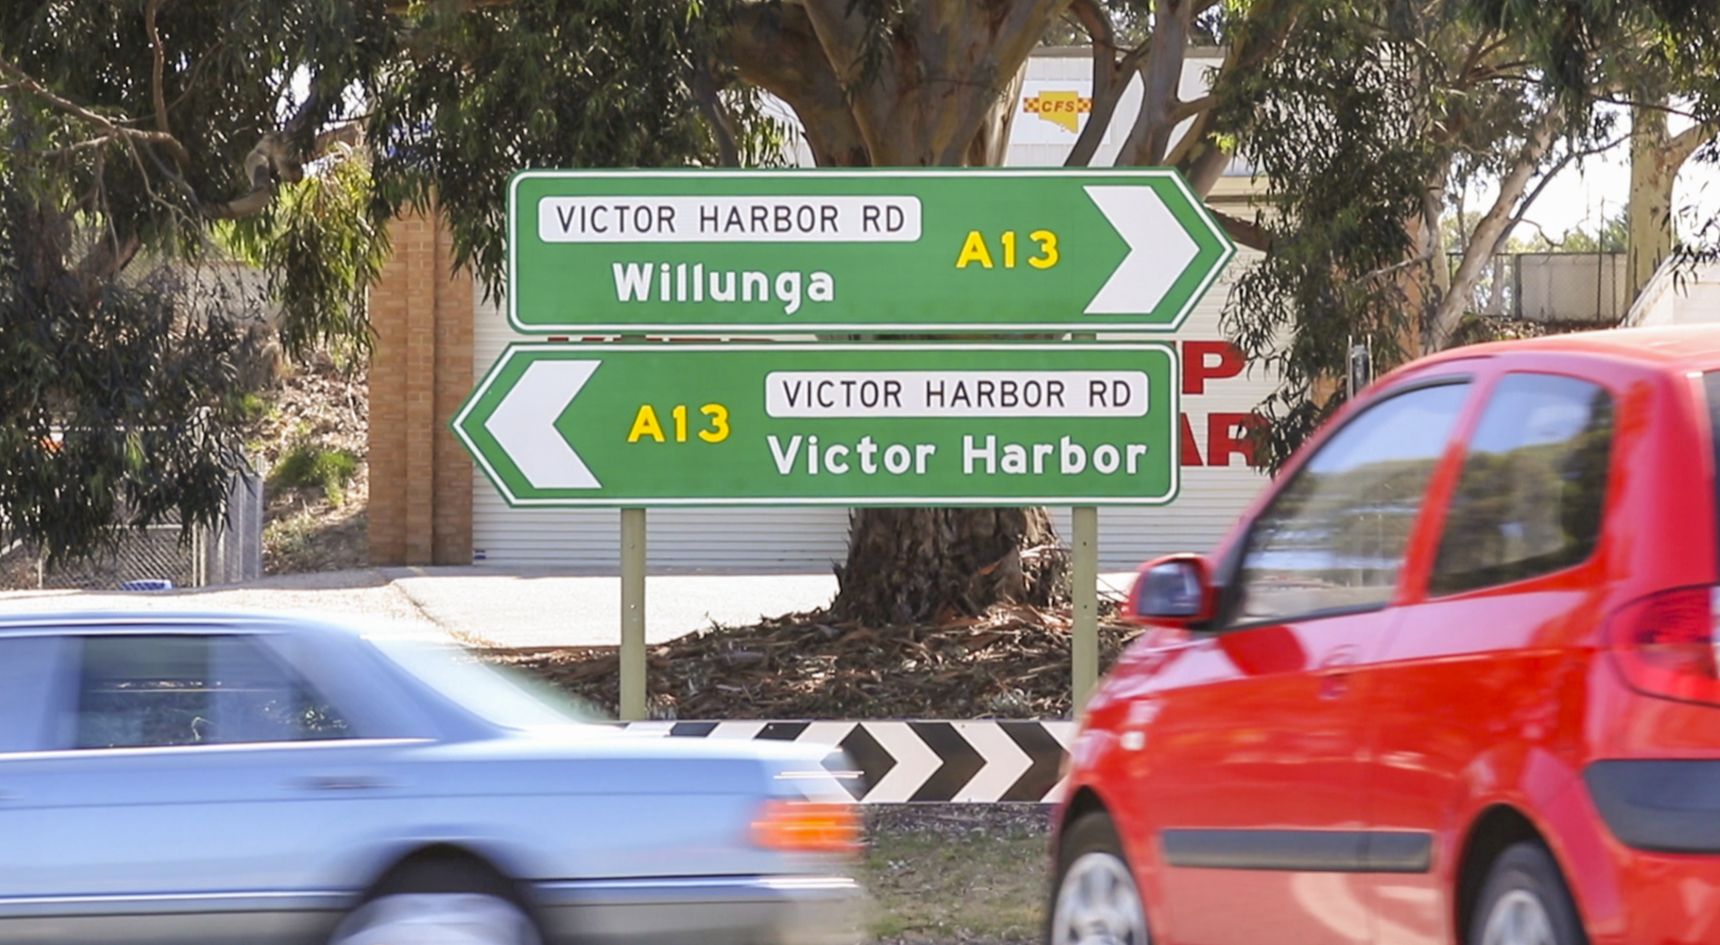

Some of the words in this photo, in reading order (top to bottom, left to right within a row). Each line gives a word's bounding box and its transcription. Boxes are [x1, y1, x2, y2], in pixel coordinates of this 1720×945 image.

[1041, 100, 1075, 113] CFS
[557, 206, 674, 233] VICTOR
[701, 206, 837, 233] HARBOR
[864, 206, 904, 232] RD
[957, 231, 1059, 269] A13
[612, 263, 834, 314] Willunga
[1171, 341, 1246, 394] P
[784, 381, 901, 408] VICTOR
[927, 381, 1065, 408] HARBOR
[1090, 381, 1131, 407] RD
[628, 404, 730, 443] A13
[767, 435, 936, 474] Victor
[963, 435, 1147, 474] Harbor
